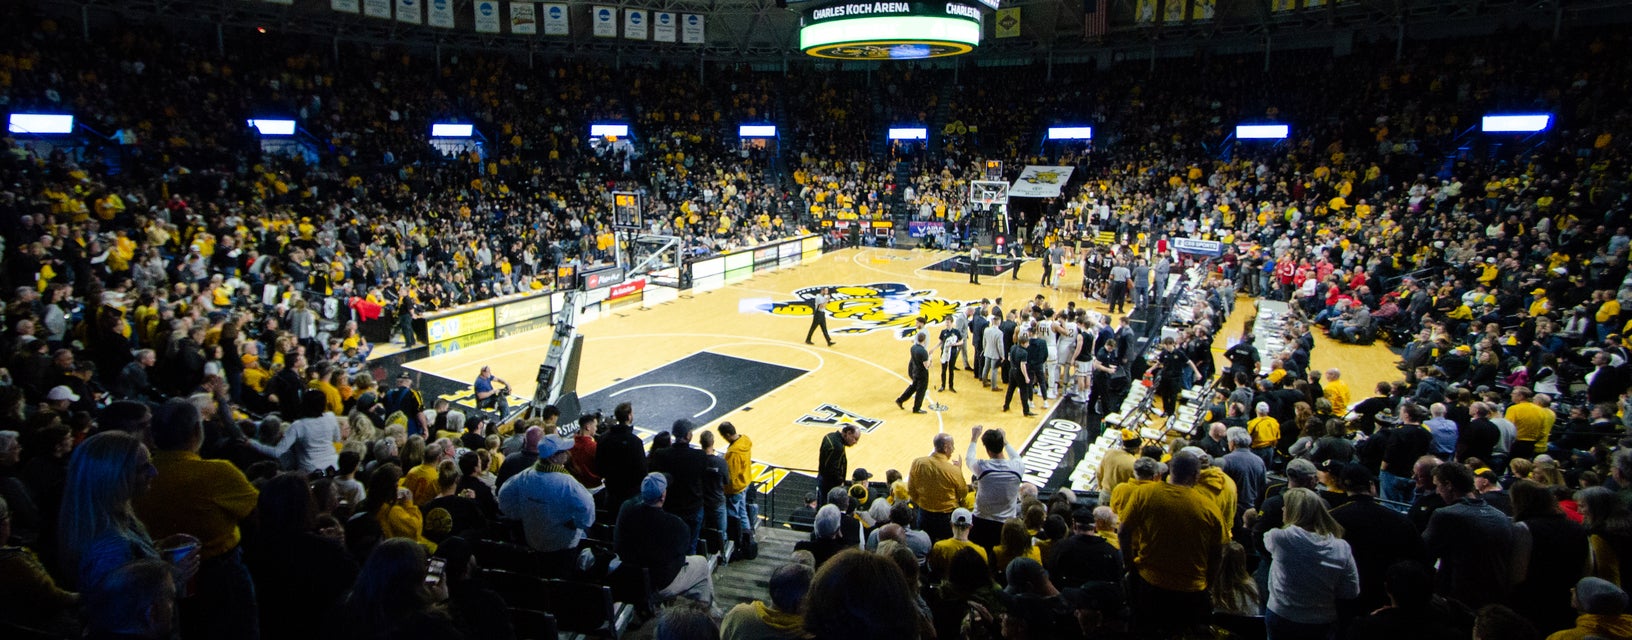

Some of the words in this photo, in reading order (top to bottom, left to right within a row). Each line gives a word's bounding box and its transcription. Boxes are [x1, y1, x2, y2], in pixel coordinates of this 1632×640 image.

[813, 5, 845, 20] CHARLES
[845, 3, 872, 15] KOCH
[873, 1, 910, 13] ARENA
[946, 2, 974, 17] CHARLES
[1040, 326, 1050, 337] 44
